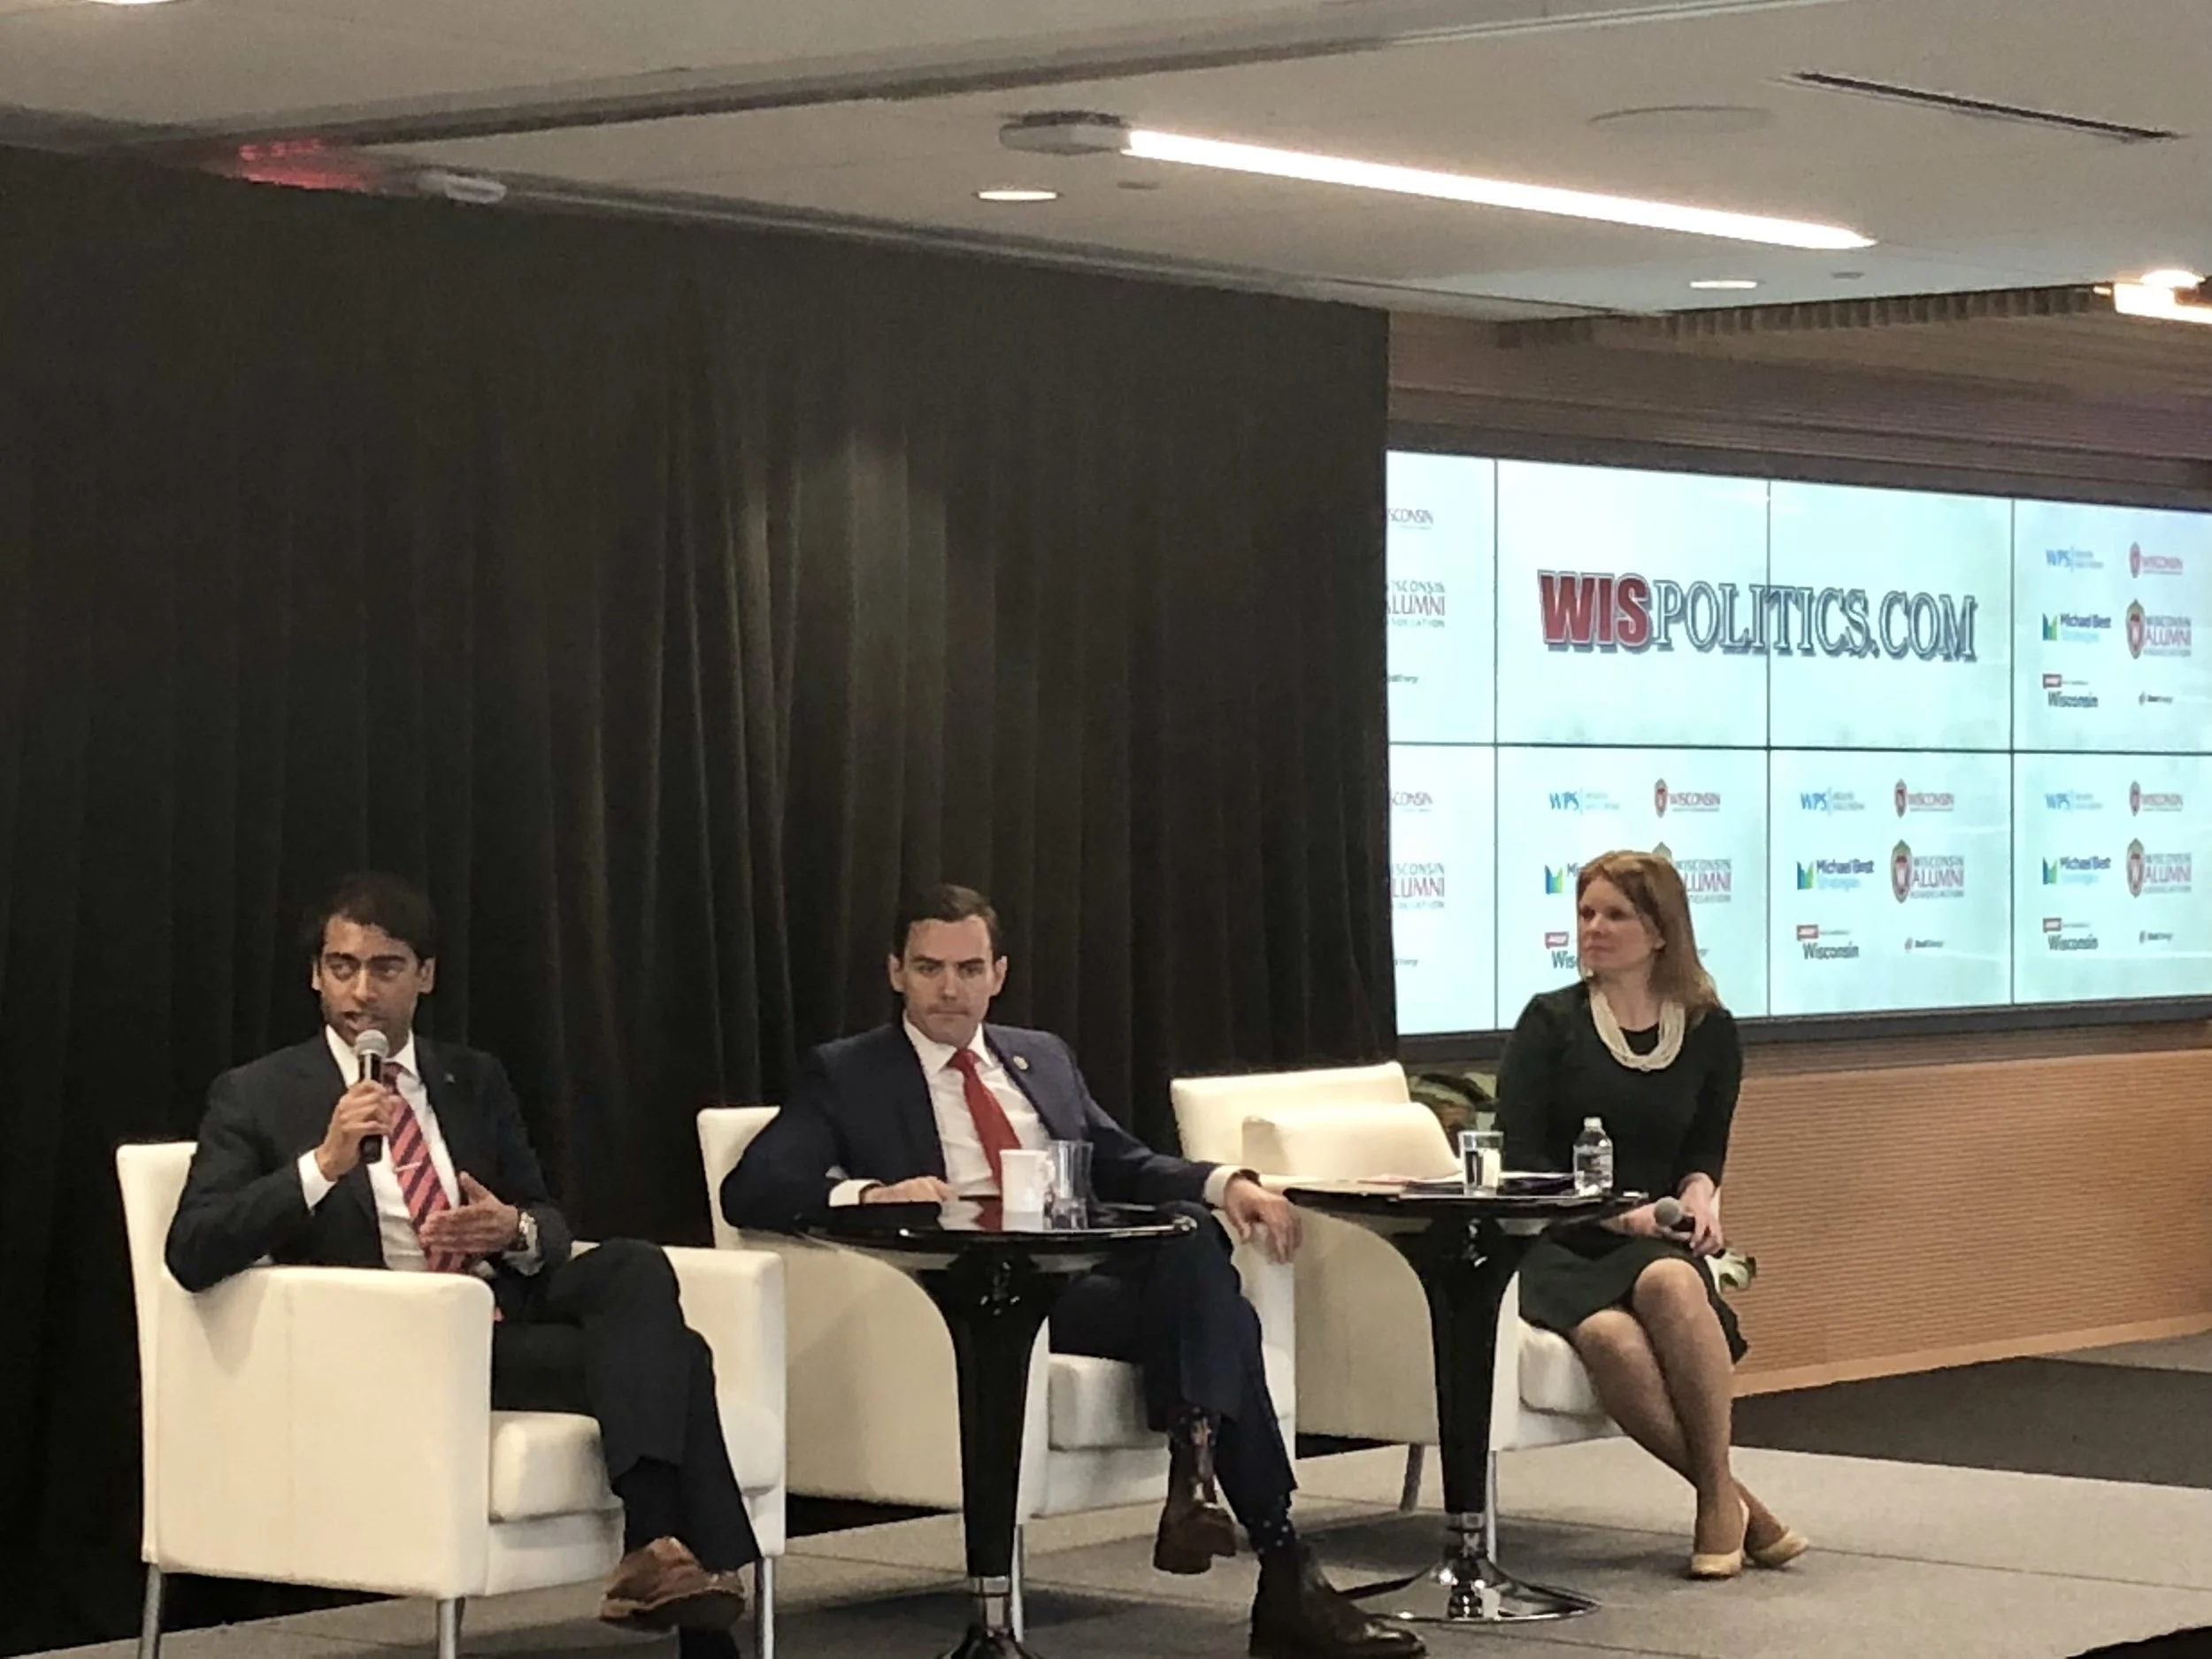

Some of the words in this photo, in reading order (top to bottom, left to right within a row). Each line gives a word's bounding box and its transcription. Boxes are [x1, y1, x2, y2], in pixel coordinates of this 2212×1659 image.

[1538, 569, 1979, 662] WISPOLITICS.COM
[1549, 792, 1579, 810] WPS
[1801, 793, 1827, 810] WPS
[1684, 872, 1732, 892] LUMNI
[1912, 868, 1964, 887] ALUMNI
[1392, 877, 1445, 898] LUMNI
